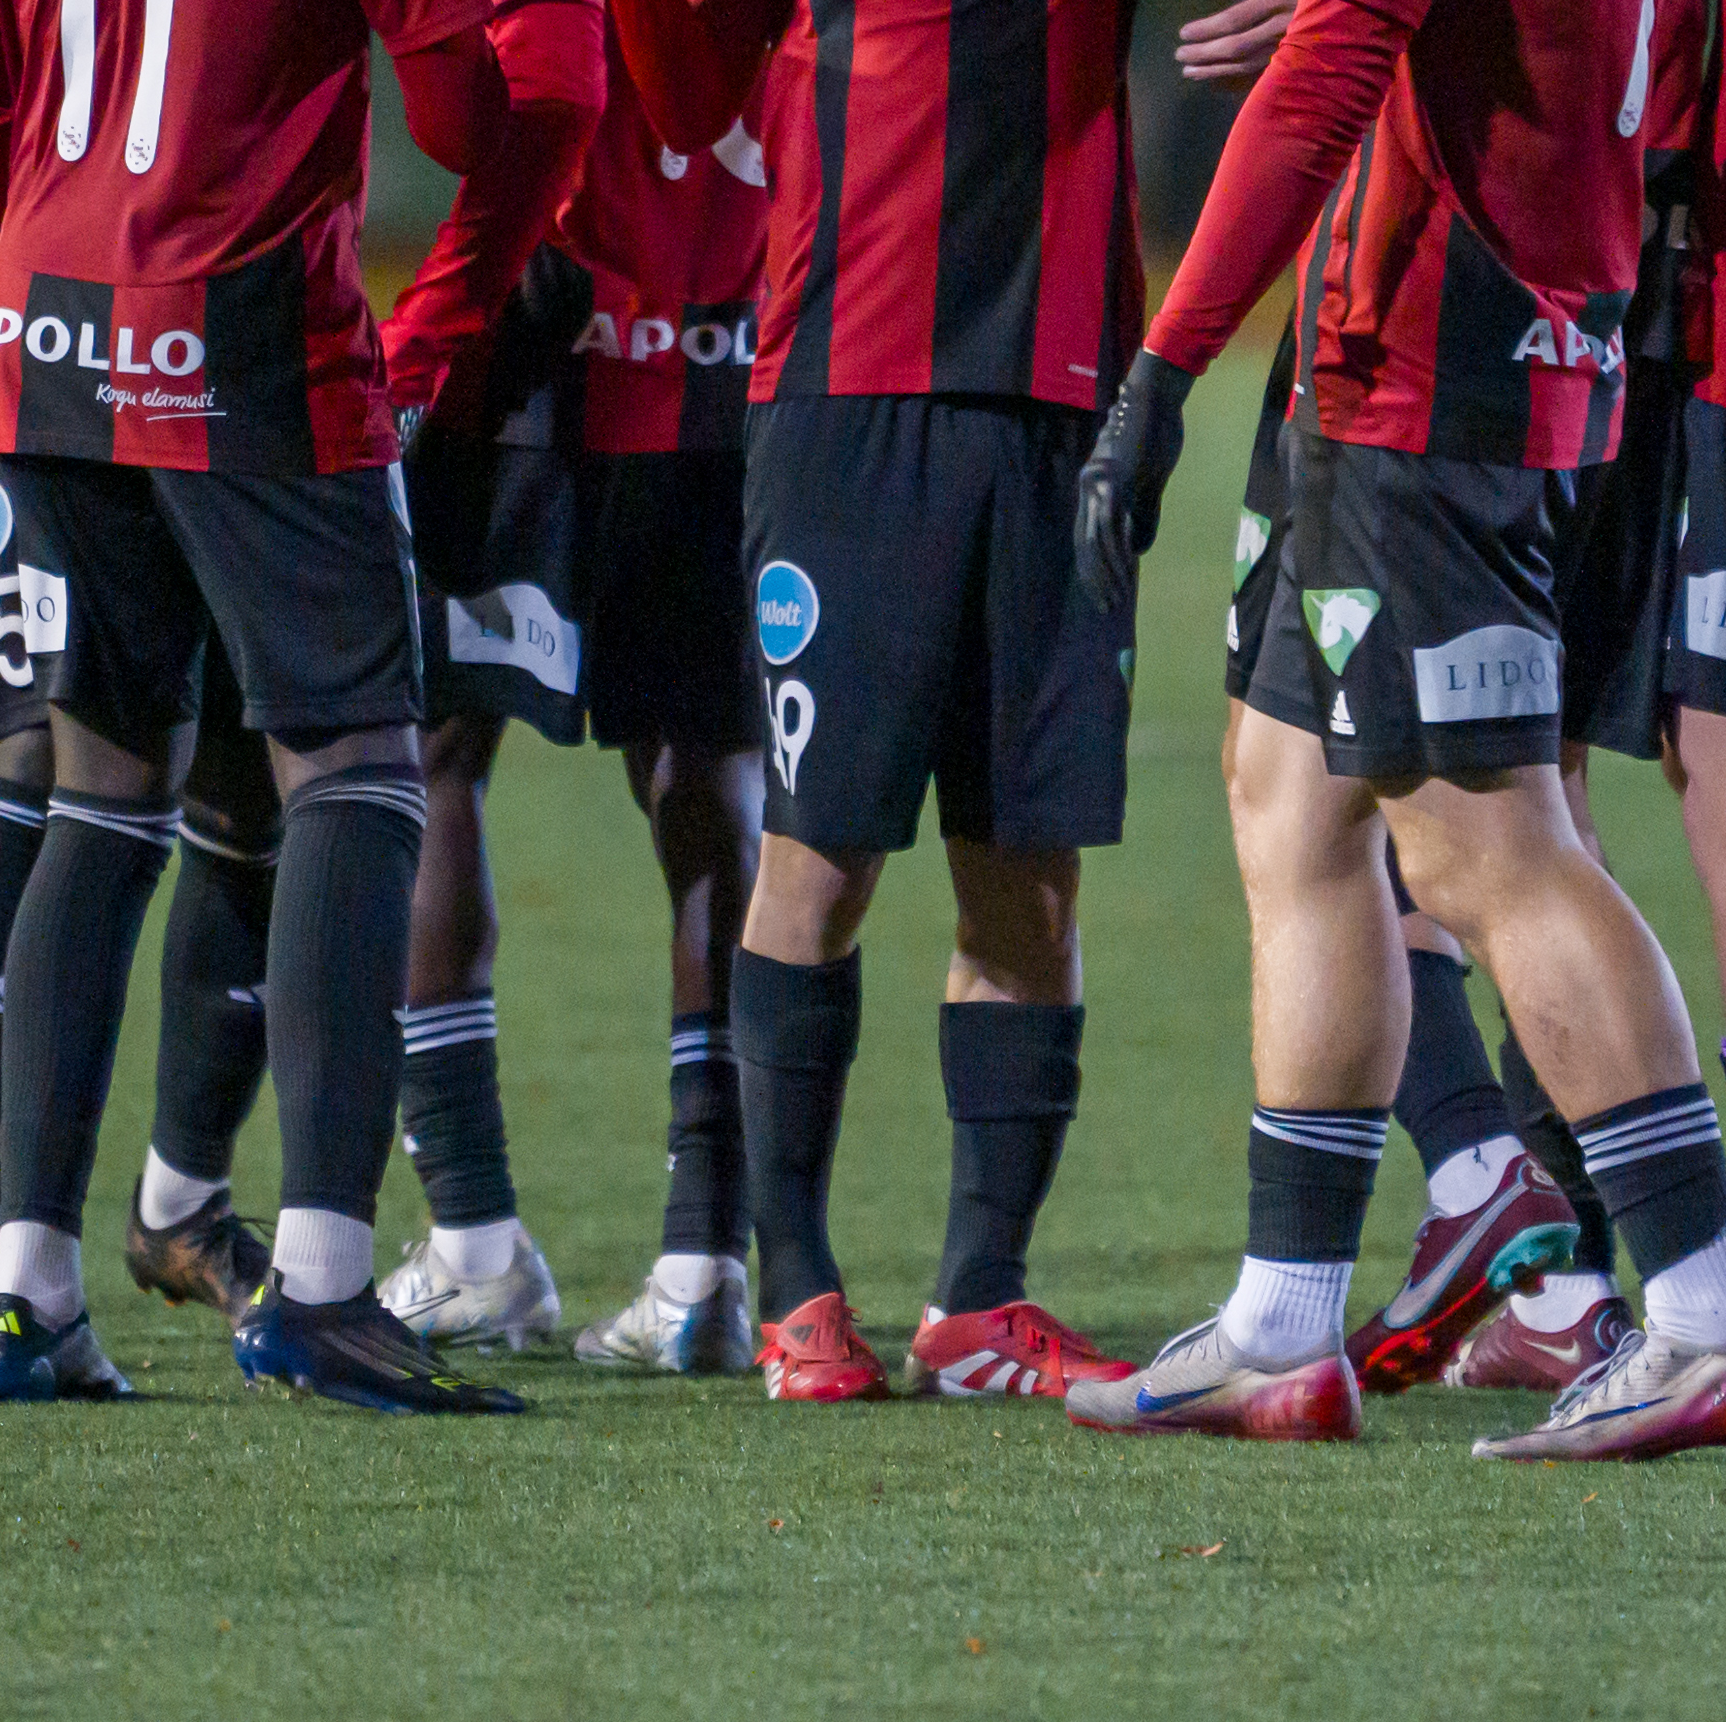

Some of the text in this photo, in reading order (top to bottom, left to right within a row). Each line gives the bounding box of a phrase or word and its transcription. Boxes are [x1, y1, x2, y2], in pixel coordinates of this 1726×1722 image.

[95, 382, 216, 413] Kogu elamusi
[760, 599, 802, 627] Wolt
[1446, 657, 1546, 692] LIDO
